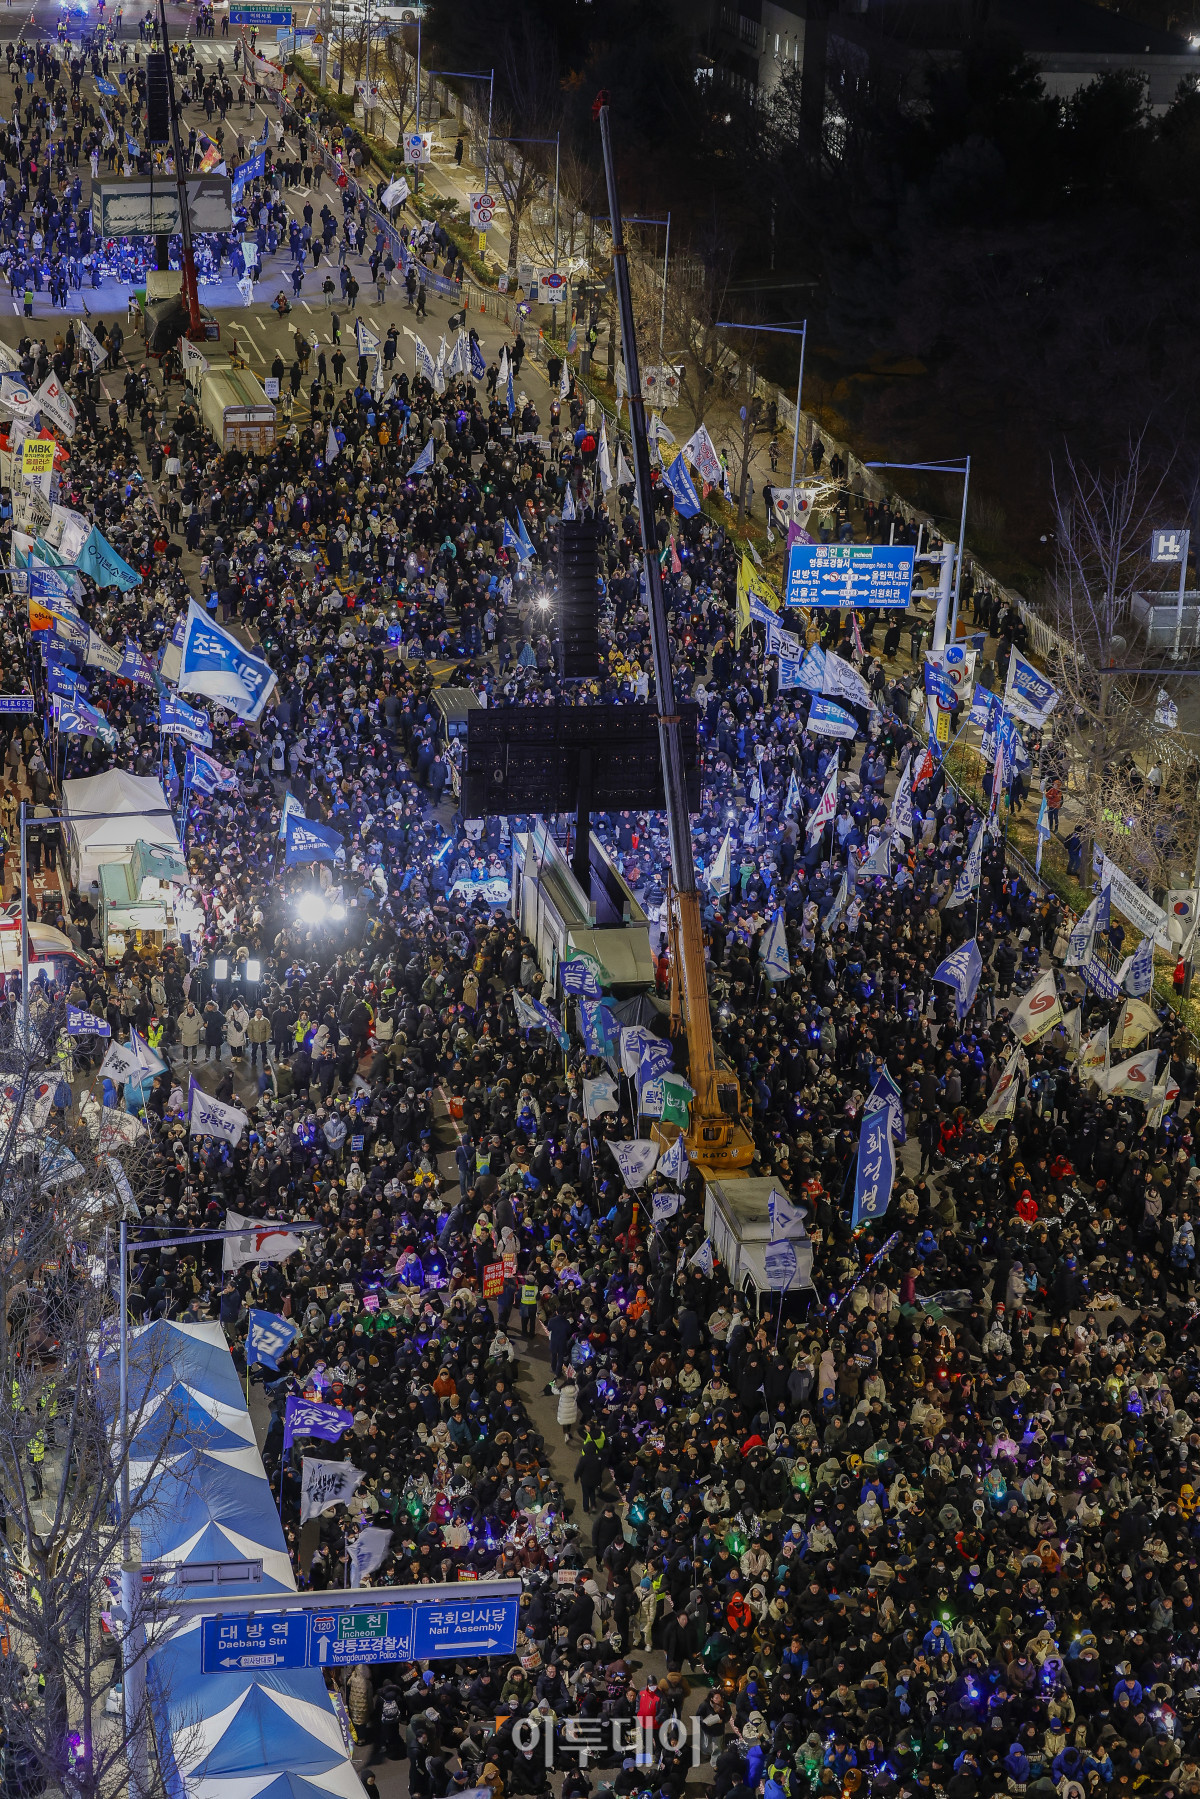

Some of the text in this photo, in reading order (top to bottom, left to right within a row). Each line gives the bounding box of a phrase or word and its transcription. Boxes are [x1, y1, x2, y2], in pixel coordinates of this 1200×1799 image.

[482, 198, 491, 206] 50
[28, 444, 51, 454] MBK
[809, 558, 850, 568] 영등포경찰서
[792, 569, 820, 580] 대방역
[871, 570, 910, 580] 올림픽대로
[790, 587, 818, 597] 서울교
[870, 589, 900, 598] 의원회관
[703, 1151, 728, 1159] KATO
[341, 1613, 382, 1631] 인천
[428, 1607, 507, 1627] 국회의사당
[220, 1621, 289, 1640] 대방역
[316, 1623, 331, 1632] 120
[429, 1622, 504, 1636] Natl Assembly
[342, 1629, 376, 1639] Incheon
[218, 1636, 288, 1651] Daebang Stn
[332, 1634, 410, 1655] 영등포경찰서
[332, 1649, 409, 1664] Yeongdeungpo Police Stn
